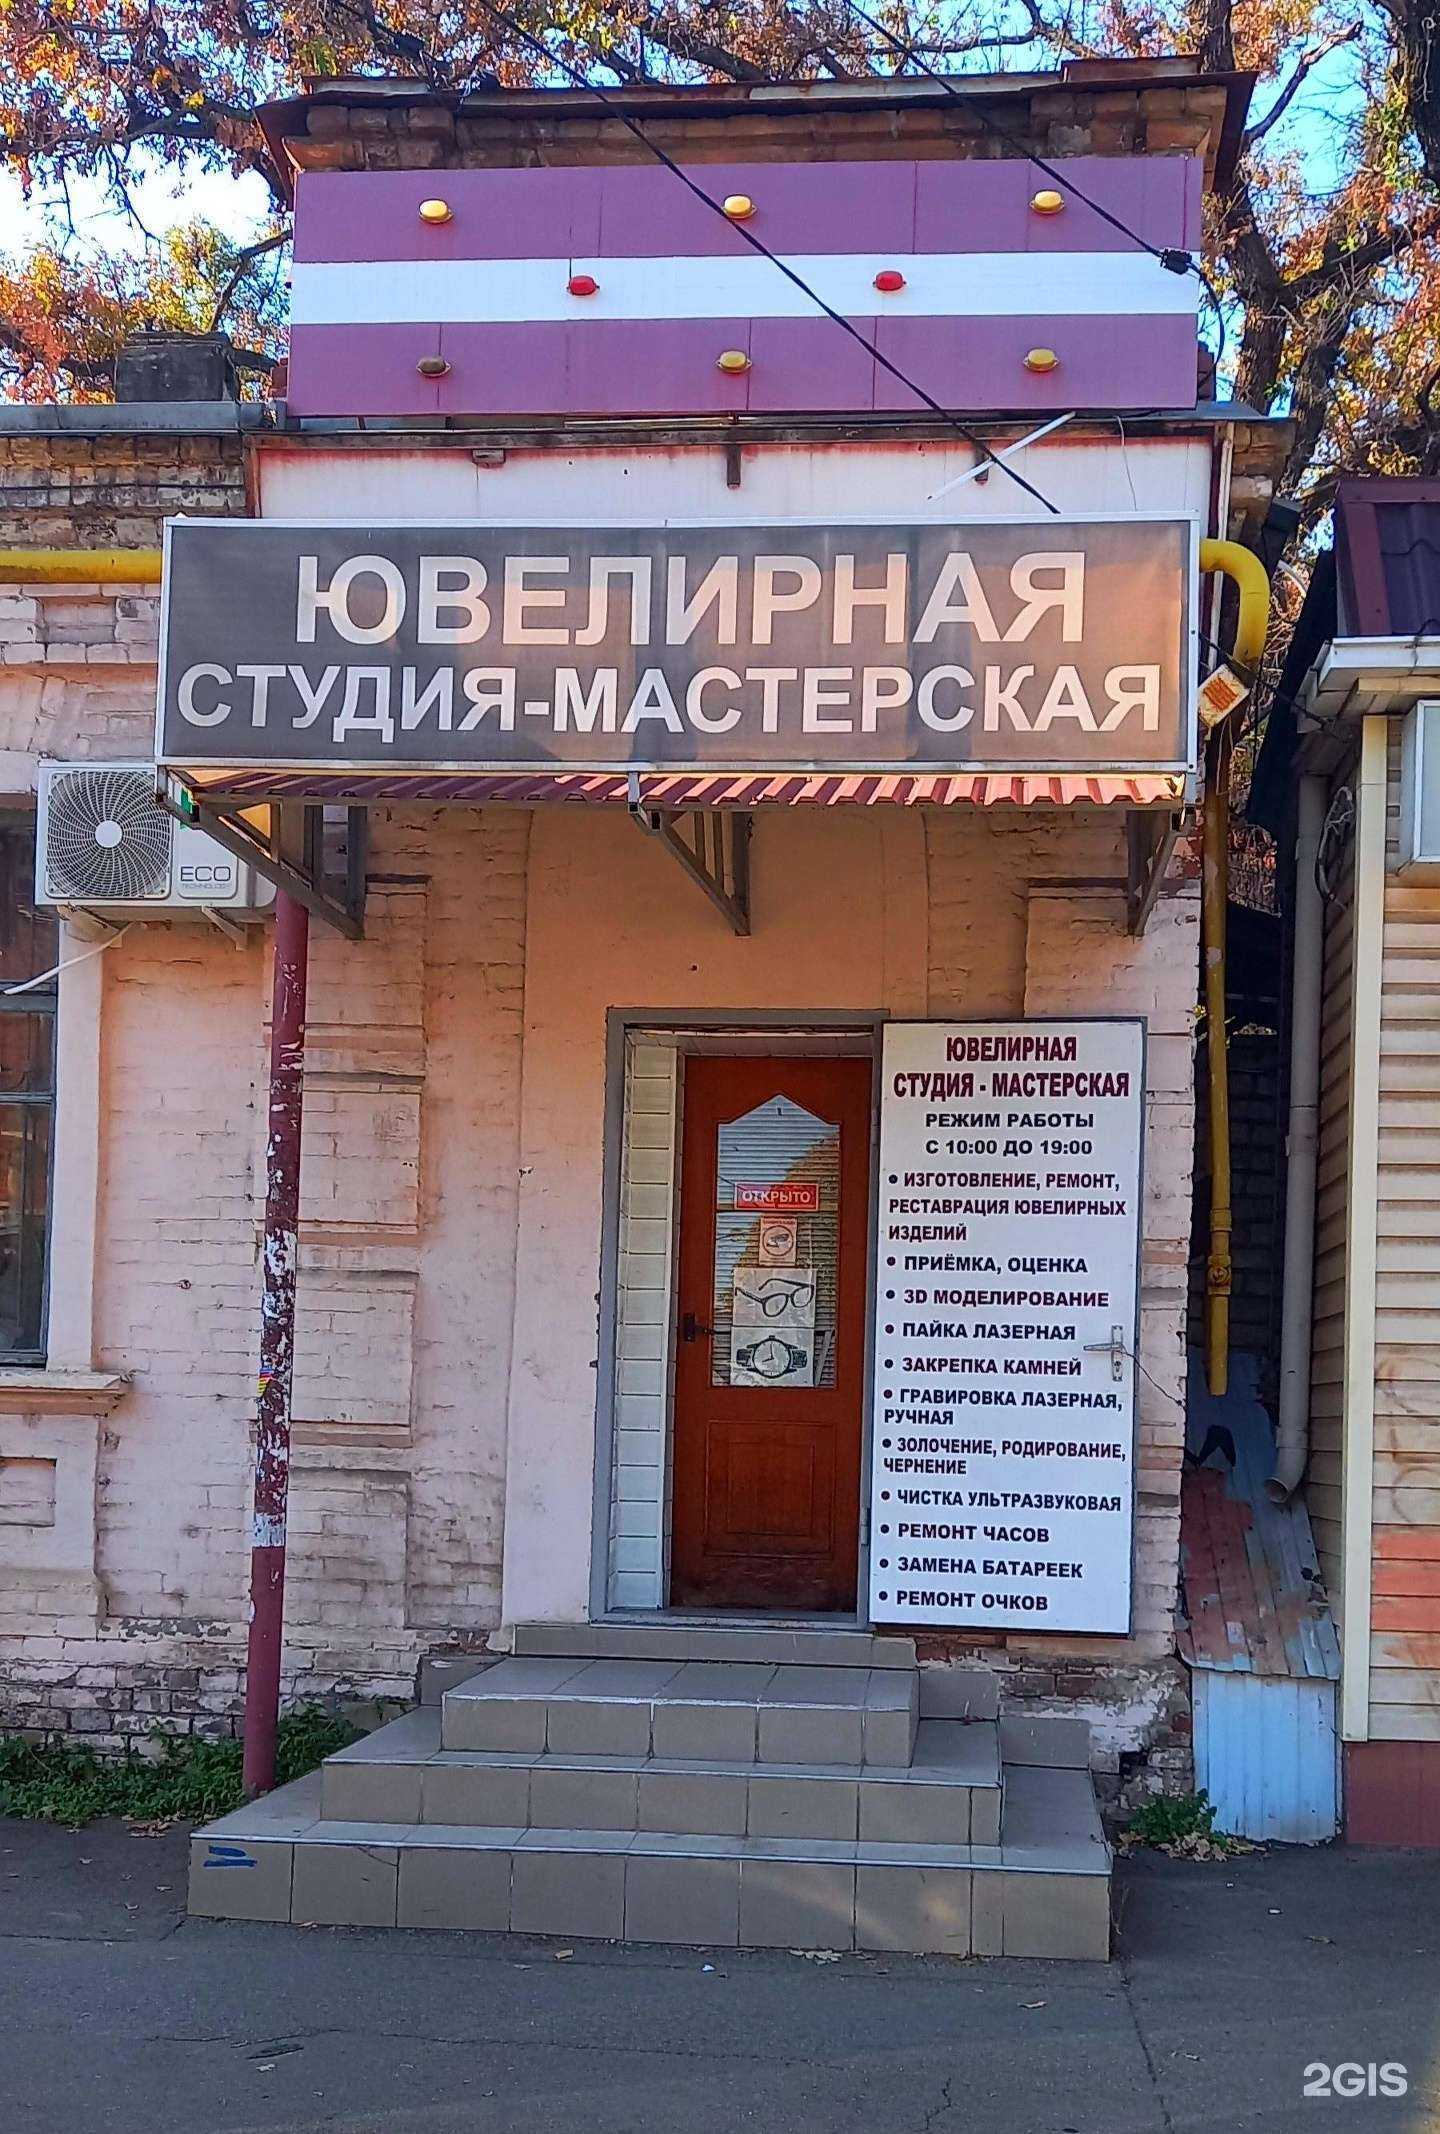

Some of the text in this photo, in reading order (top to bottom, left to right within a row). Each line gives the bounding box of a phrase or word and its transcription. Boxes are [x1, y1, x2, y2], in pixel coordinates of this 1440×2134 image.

[296, 551, 1086, 646] ЮВЕЛИРНАЯ
[176, 662, 1161, 744] СТУДИЯ-МАСТЕРСКАЯ
[180, 866, 231, 882] ECO
[946, 1036, 1076, 1062] ЮВЕЛИРНАЯ
[893, 1072, 974, 1101] СТУДИЯ
[992, 1072, 1129, 1098] МАСТЕРСКАЯ
[926, 1113, 1094, 1128] РЕЖИМ РАБОТЫ
[946, 1140, 998, 1154] 10:00
[1003, 1140, 1033, 1156] ДО
[1040, 1140, 1092, 1155] 19:00
[904, 1172, 1120, 1191] ИЗГОТОВЛЕНИЕ, РЕМОНТ,
[742, 1190, 811, 1203] ОТКРЫТО
[889, 1199, 1126, 1216] РЕСТАВРАЦИЯ ЮВЕЛИРНЫХ
[889, 1222, 967, 1242] ИЗДЕЛИЙ
[904, 1254, 1088, 1274] ПРИЁМКА, ОЦЕНКА
[904, 1290, 1109, 1308] 3D МОДЕЛИРОВАНИЕ
[902, 1320, 1076, 1340] ПАЙКА ЛАЗЕРНАЯ
[902, 1358, 1082, 1376] ЗАКРЕПКА КАМНЕЙ
[900, 1388, 1122, 1411] ГРАВИРОВКА ЛАЗЕРНАЯ,
[884, 1408, 954, 1425] РУЧНАЯ
[897, 1438, 1126, 1462] ЗОЛОЧЕНИЕ, РОДИРОВАНИЕ,
[884, 1458, 966, 1474] ЧЕРНЕНИЕ
[897, 1489, 1121, 1512] ЧИСТКА УЛЬТРАЗВУКОВАЯ
[898, 1523, 1050, 1542] РЕМОНТ ЧАСОВ
[898, 1556, 1083, 1578] ЗАМЕНА БАТАРЕЕК
[896, 1590, 1048, 1610] РЕМОНТ ОЧКОВ
